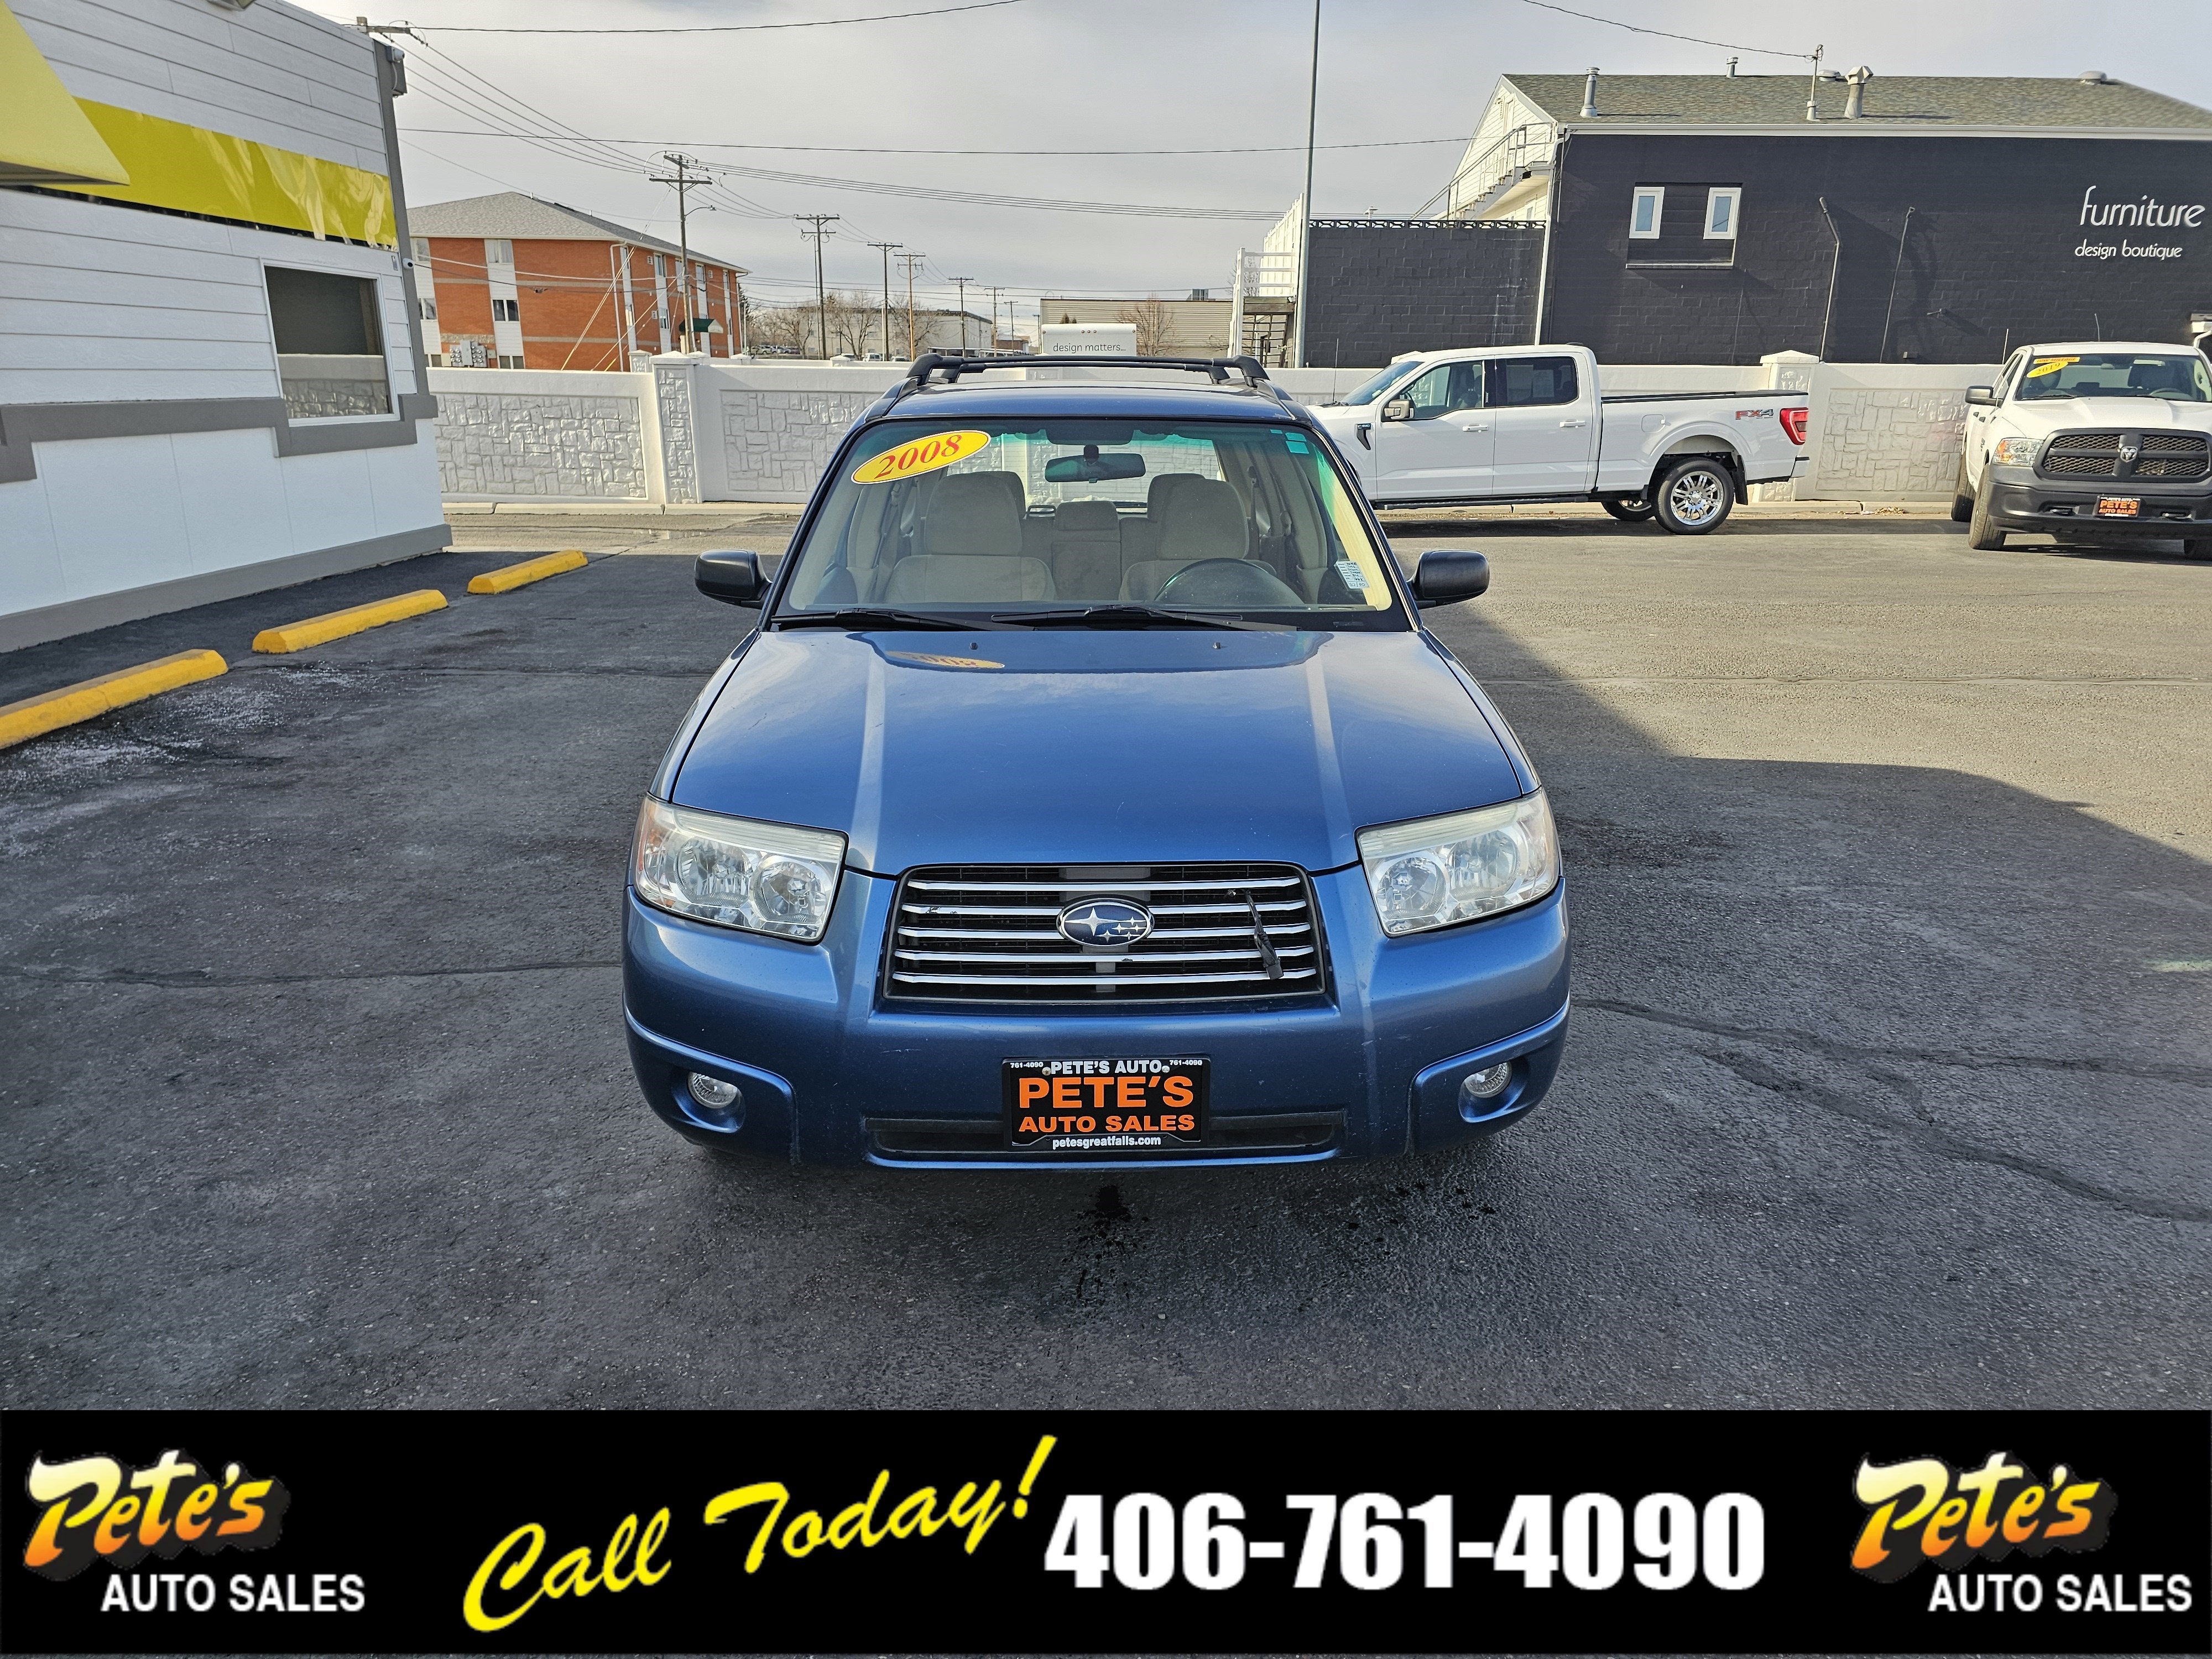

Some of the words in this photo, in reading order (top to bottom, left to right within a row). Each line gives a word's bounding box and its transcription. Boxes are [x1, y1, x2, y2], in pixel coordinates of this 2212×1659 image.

[2079, 185, 2205, 227] furniture
[2074, 239, 2116, 260] design
[2121, 239, 2183, 261] boutique
[1053, 343, 1082, 354] design
[1085, 343, 1126, 352] matters...
[1735, 409, 1773, 420] FX4
[874, 435, 962, 479] 2008
[2100, 500, 2137, 509] PETE'S
[1051, 1060, 1110, 1074] PETE'S
[1114, 1060, 1162, 1073] AUTO
[1019, 1076, 1193, 1108] PETE'S
[1019, 1117, 1095, 1133] AUTO
[1105, 1115, 1195, 1131] SALES
[1052, 1135, 1161, 1150] petesgreatfalls.com
